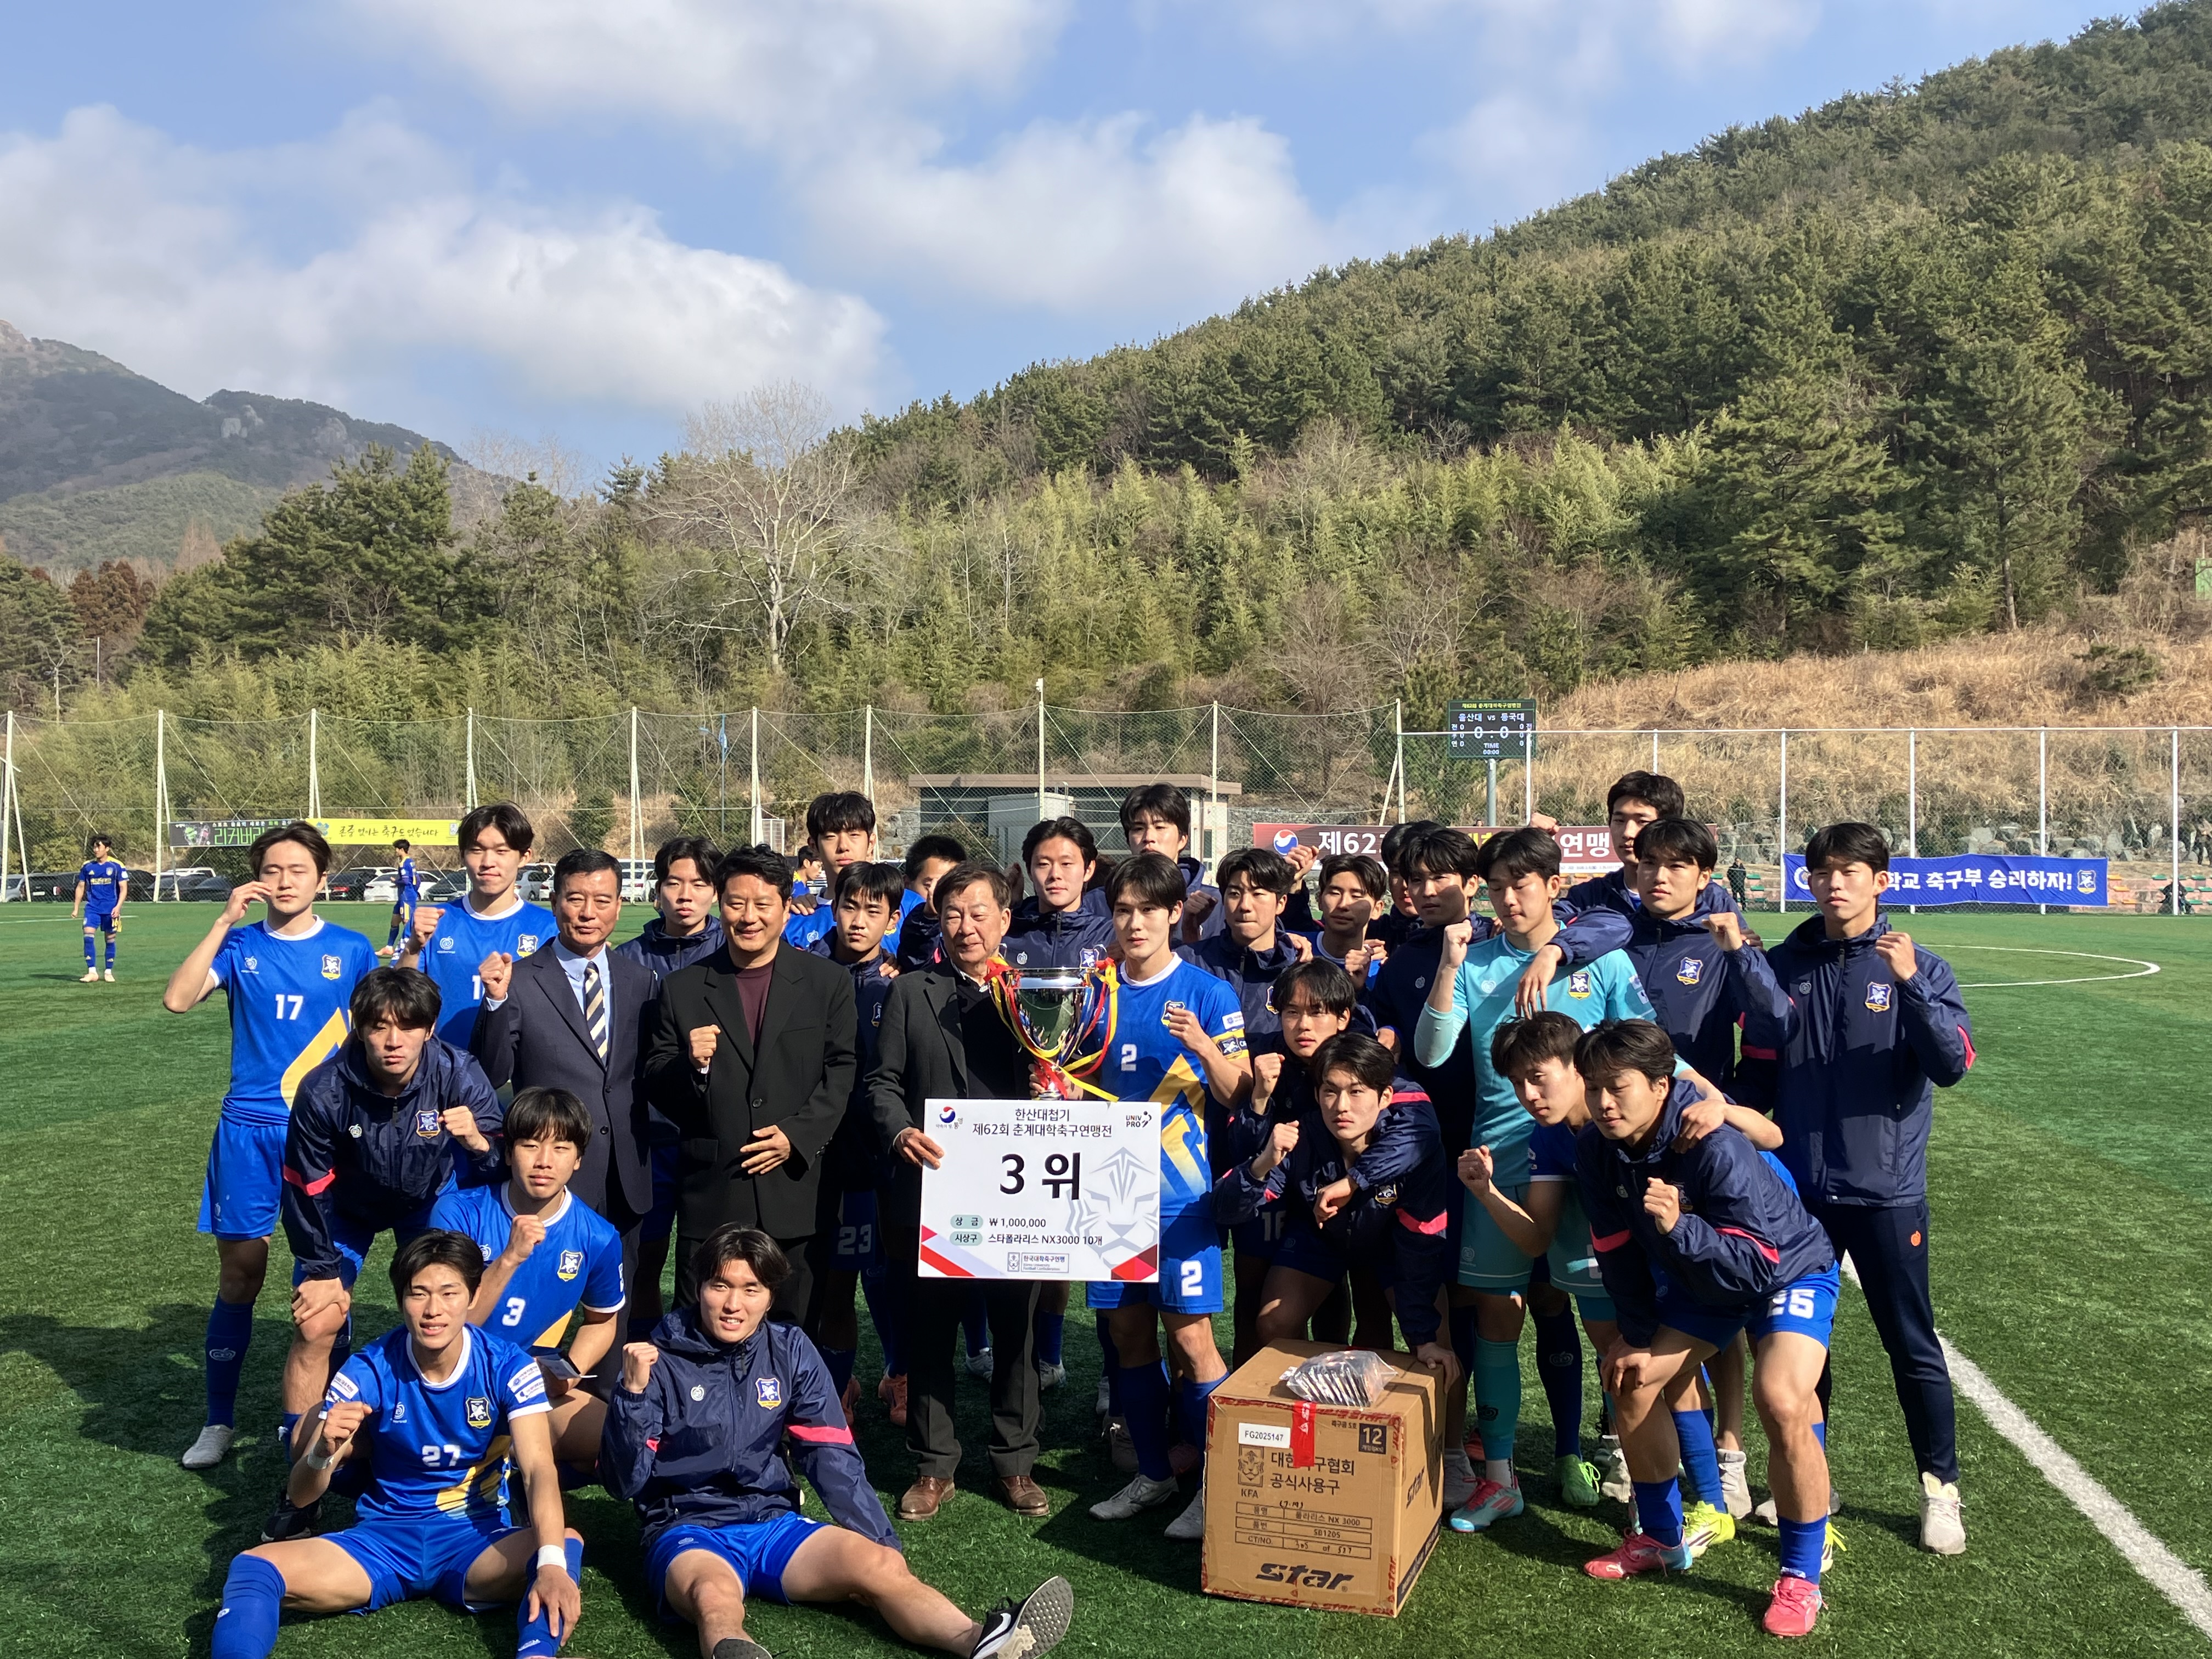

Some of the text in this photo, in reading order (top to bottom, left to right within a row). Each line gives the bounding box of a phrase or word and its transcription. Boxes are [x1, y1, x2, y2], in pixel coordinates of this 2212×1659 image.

[1458, 713, 1482, 722] 울산대
[1500, 713, 1525, 722] 동국대
[1474, 726, 1483, 739] 0
[1500, 726, 1509, 739] 0
[338, 824, 438, 838] 존중 없이는 축구도 없습니다
[1926, 867, 1983, 891] 축구부
[1988, 869, 2072, 891] 승리하자!
[275, 994, 304, 1020] 17
[1120, 1043, 1137, 1071] 2
[1015, 1108, 1070, 1122] 한산대첩기
[973, 1123, 1112, 1138] 제62회 춘계대학축구연맹전
[1000, 1152, 1081, 1200] 3 위
[1001, 1218, 1046, 1228] 1,000,000
[837, 1223, 872, 1255] 23
[955, 1234, 978, 1243] 시상구
[988, 1234, 1103, 1245] 스타폴라리스 NX3000 10개
[1023, 1255, 1065, 1263] 한국대학축구연맹
[1181, 1260, 1203, 1297] 2
[501, 1296, 527, 1327] 3
[1244, 1430, 1284, 1442] FG2025147
[1363, 1427, 1383, 1445] 12
[422, 1444, 461, 1468] 27
[1271, 1452, 1355, 1476] 대한구협회
[1270, 1472, 1341, 1496] 공식사용구
[1241, 1488, 1259, 1499] KFA
[1342, 1517, 1361, 1527] 3000
[1323, 1544, 1330, 1553] of
[1256, 1562, 1355, 1590] star
